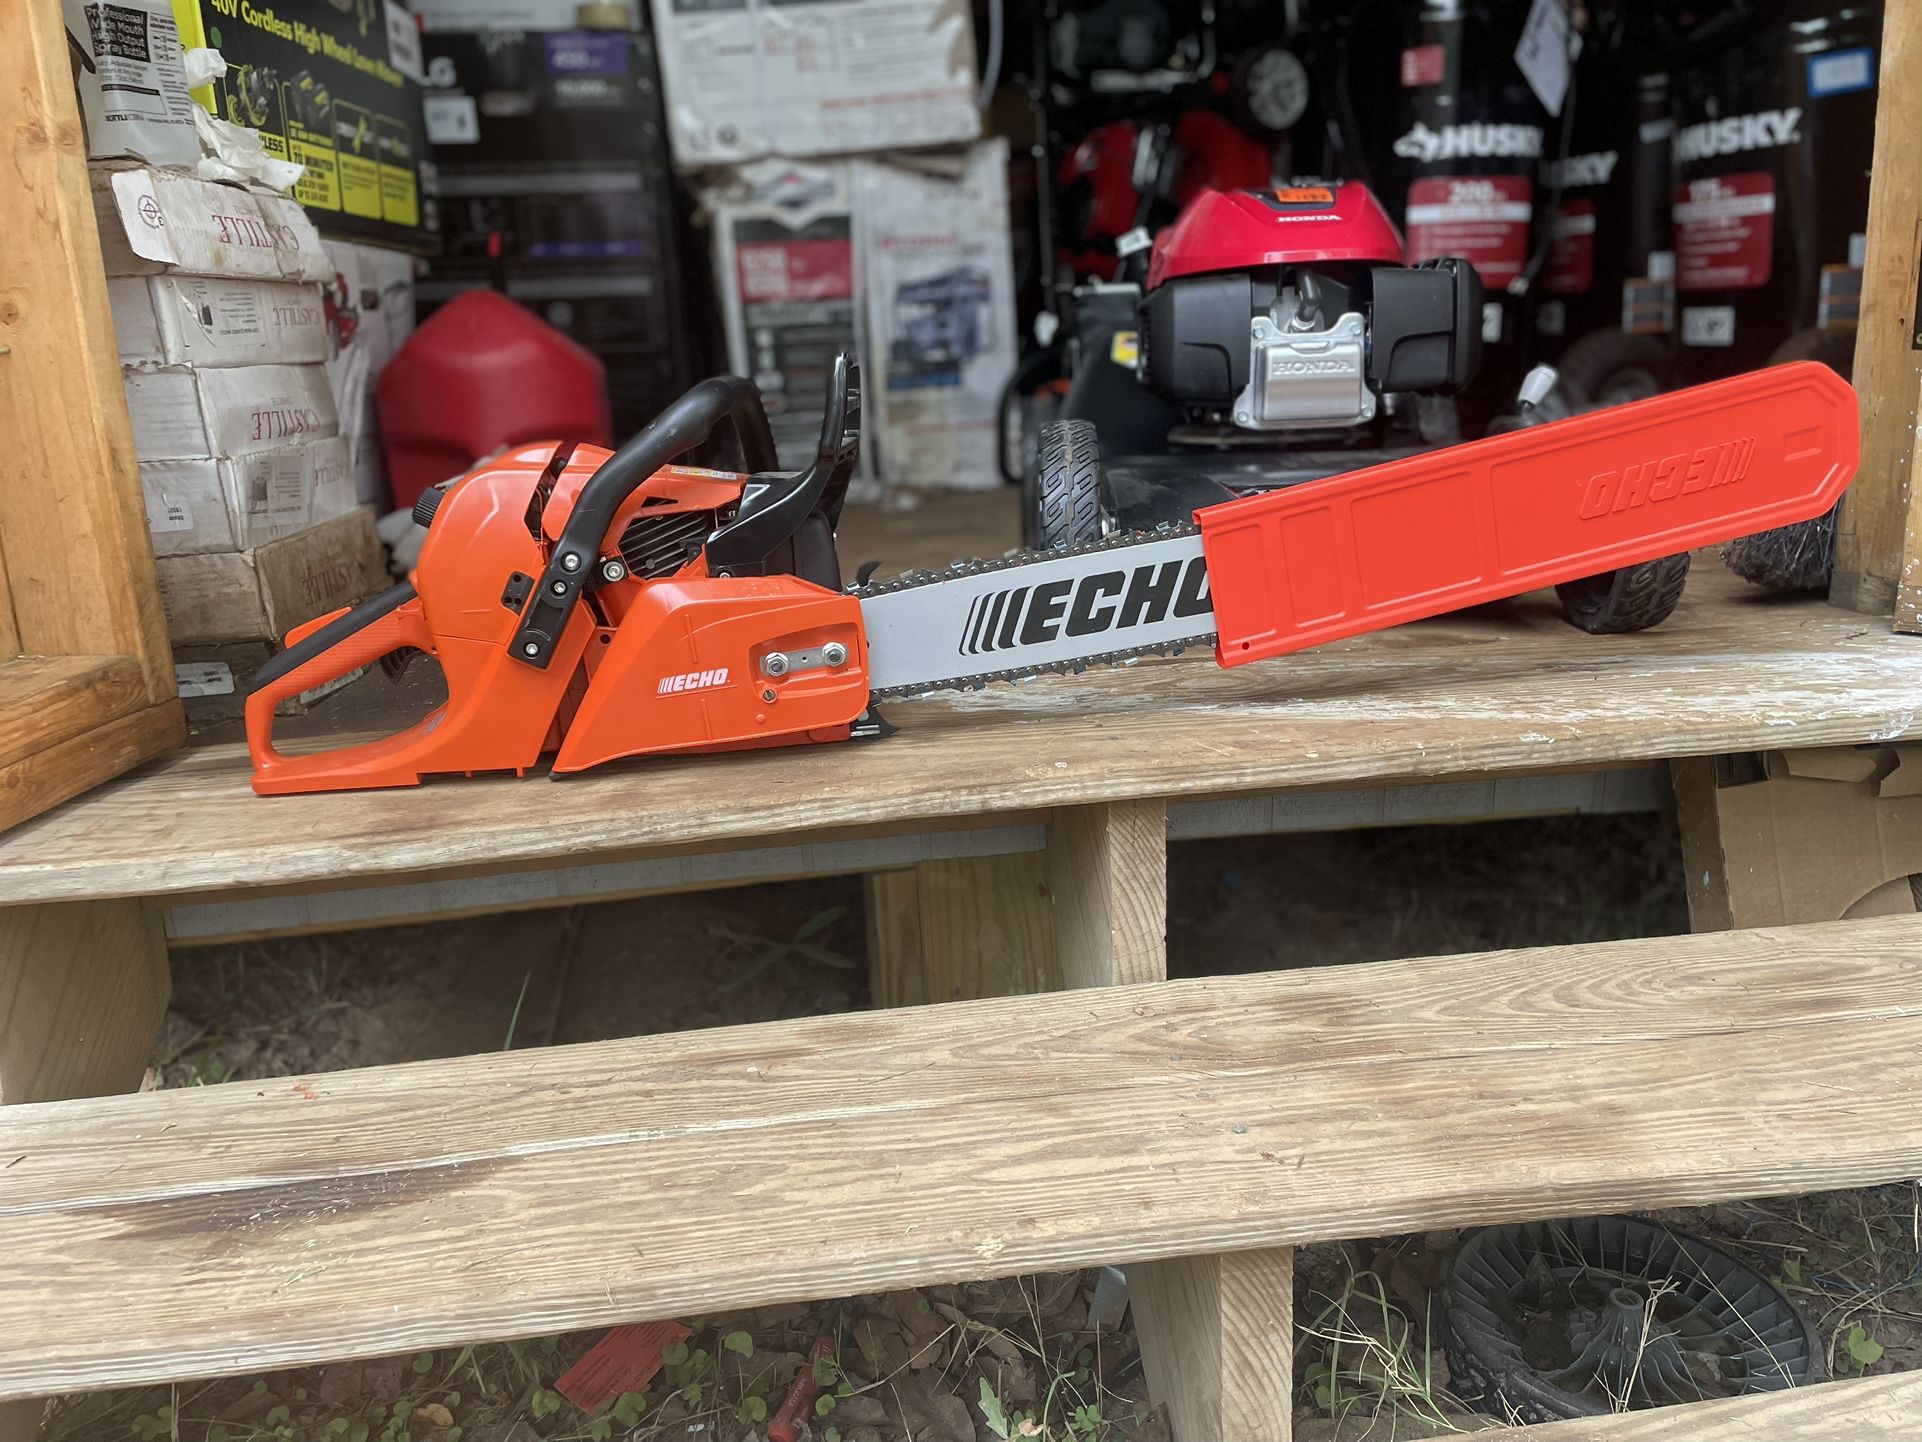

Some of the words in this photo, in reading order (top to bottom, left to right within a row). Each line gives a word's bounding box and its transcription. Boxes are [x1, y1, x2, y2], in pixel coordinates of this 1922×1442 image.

[117, 22, 144, 36] Mouth
[241, 1, 293, 41] Cordless
[293, 21, 320, 55] High
[95, 42, 122, 56] Spray
[122, 44, 147, 59] Bottle
[116, 33, 145, 49] Output
[1277, 214, 1342, 223] HONDA
[212, 215, 301, 251] CASTILLE
[272, 307, 321, 327] CASTILLE
[1273, 360, 1356, 376] HONDA
[252, 408, 321, 441] CASTILLE
[1578, 446, 1720, 521] ECHO
[1019, 556, 1214, 645] ECHO
[671, 667, 730, 693] ECHO
